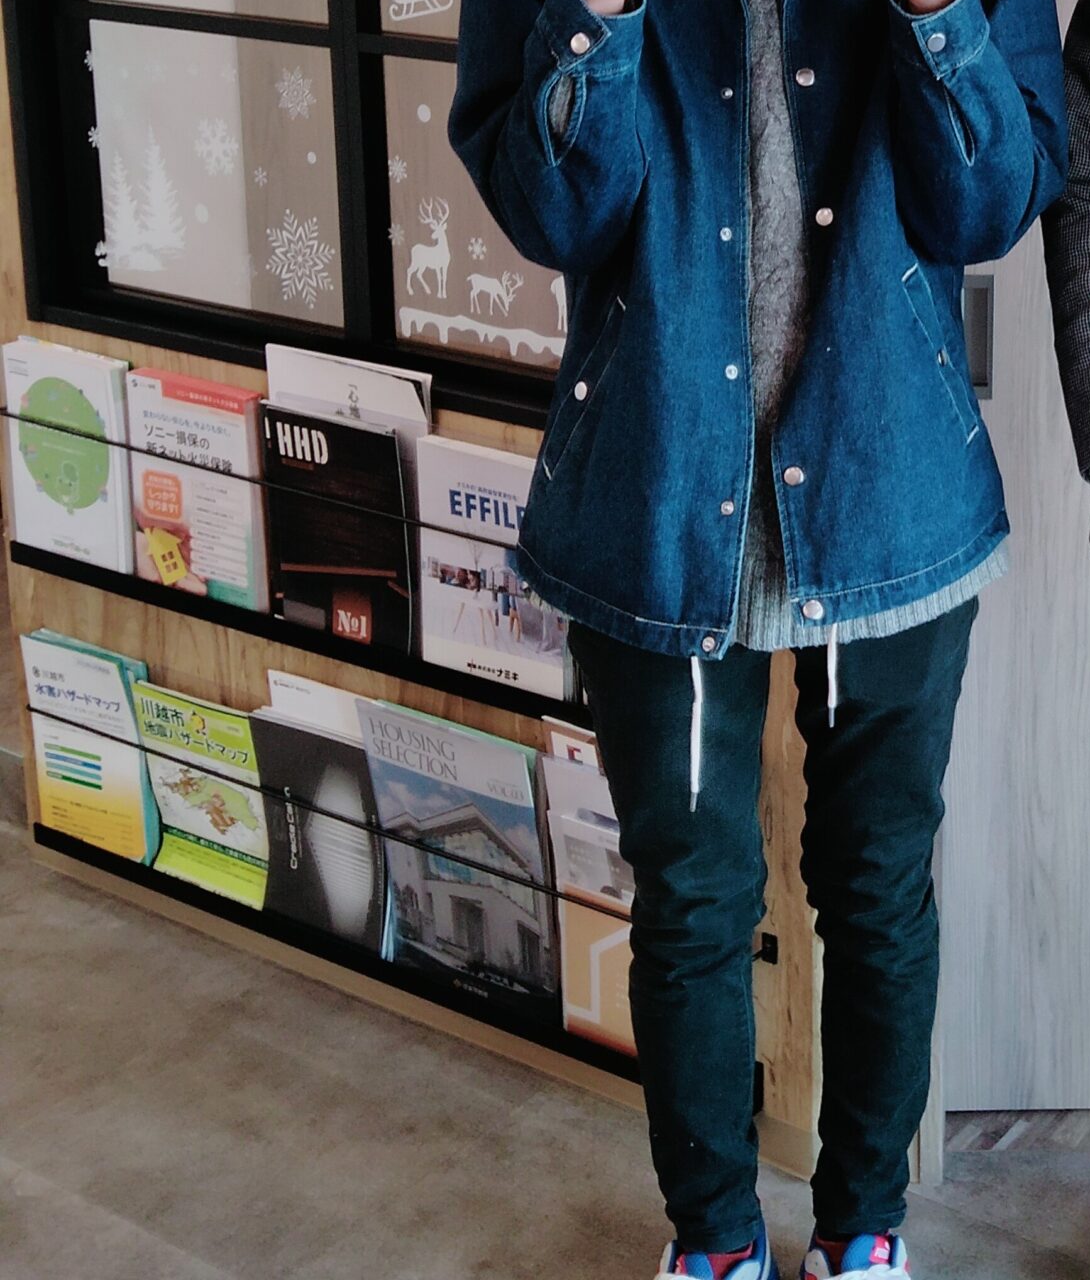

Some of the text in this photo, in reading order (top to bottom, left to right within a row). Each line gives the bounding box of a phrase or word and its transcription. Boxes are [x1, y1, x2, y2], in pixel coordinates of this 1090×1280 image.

[144, 423, 210, 450] ソニー損保の
[276, 421, 329, 465] HHD
[34, 683, 120, 712] 水害ハザードマップ
[141, 697, 185, 727] 川越市
[144, 720, 248, 764] 地震ハザードマップ
[368, 716, 456, 762] HOUSING
[372, 737, 458, 781] SELECTION
